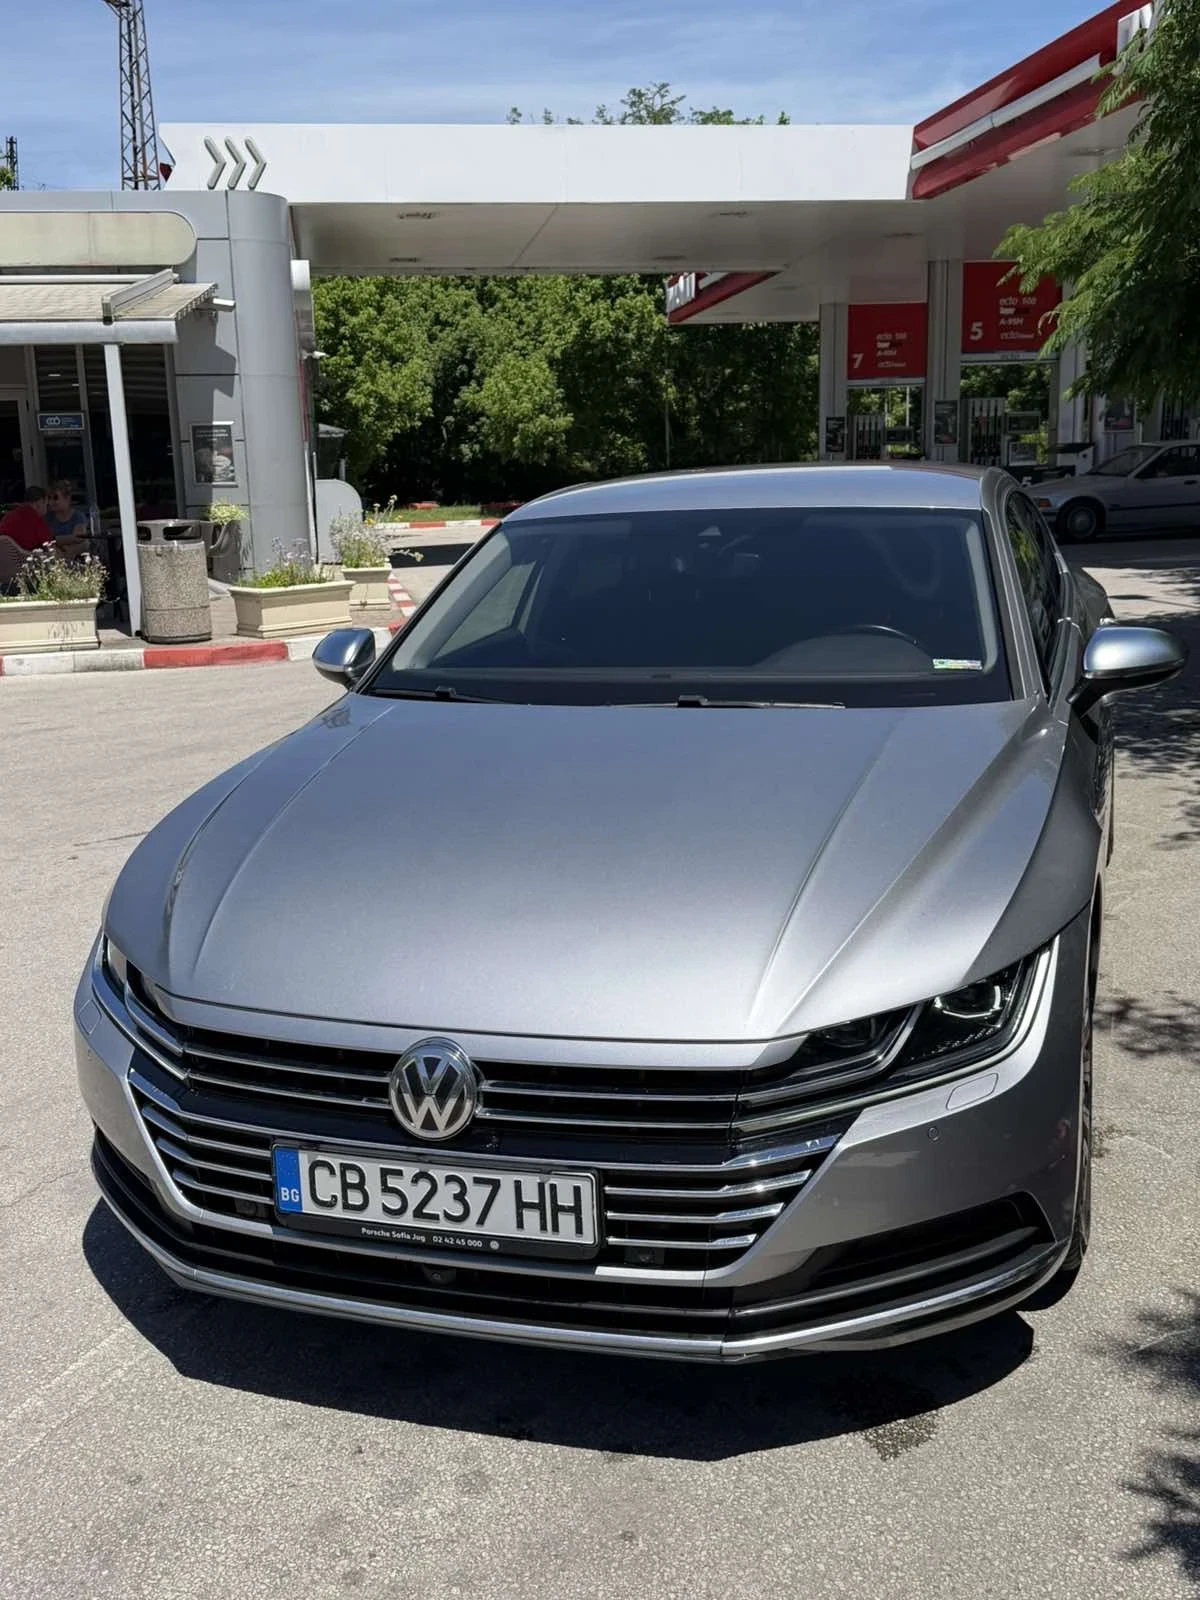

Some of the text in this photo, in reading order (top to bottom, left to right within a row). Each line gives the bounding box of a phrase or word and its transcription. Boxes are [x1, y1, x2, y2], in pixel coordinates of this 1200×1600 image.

[969, 321, 984, 341] 5
[851, 352, 865, 369] 7
[281, 1187, 300, 1203] BG
[308, 1159, 583, 1238] CB 5237 HH
[361, 1227, 390, 1238] Porsche
[391, 1231, 411, 1240] Sofia
[432, 1235, 442, 1243] 02
[444, 1237, 455, 1245] 42
[456, 1238, 466, 1246] 45
[467, 1239, 483, 1248] 000
